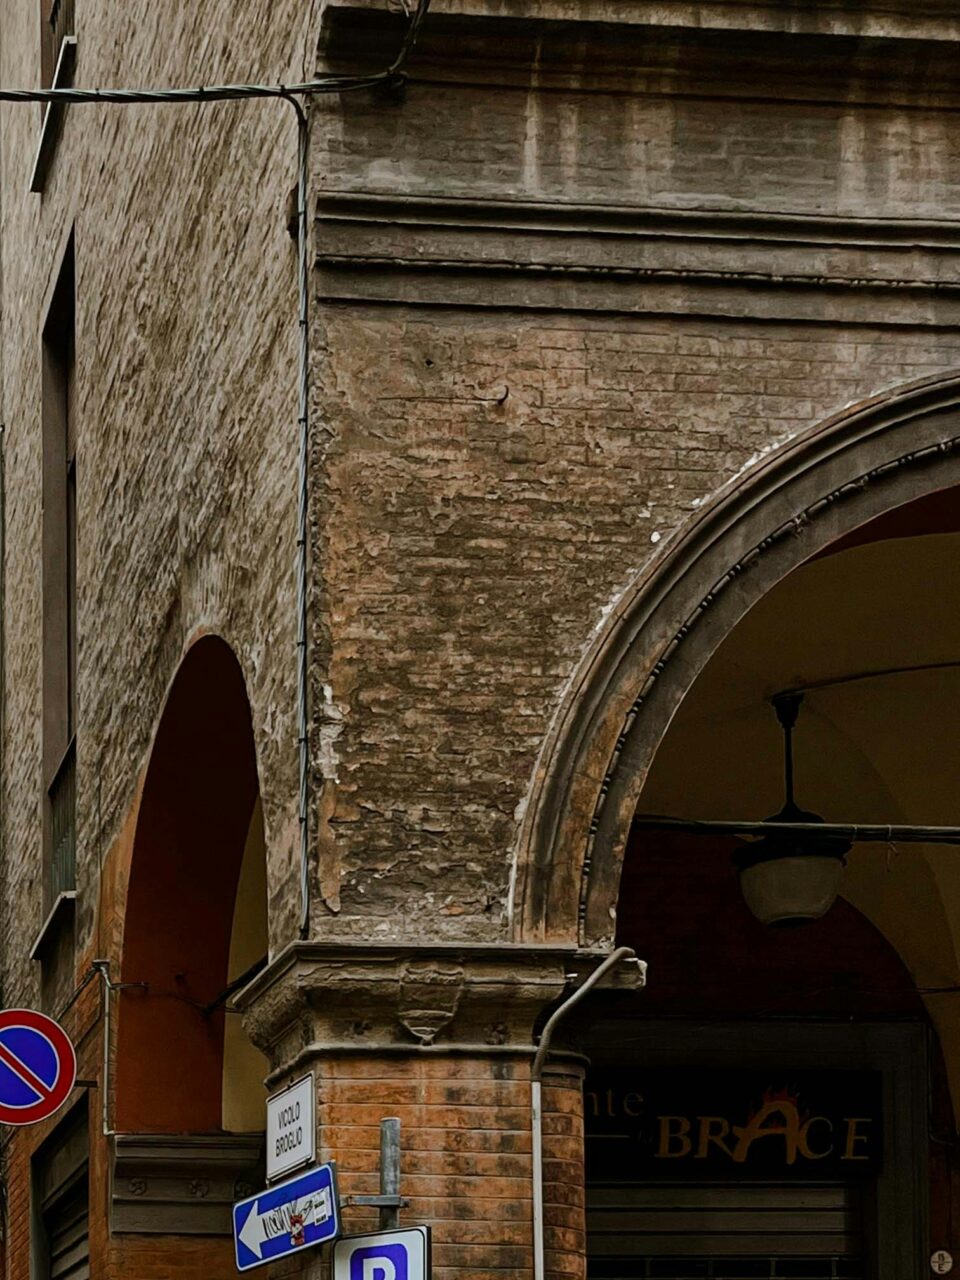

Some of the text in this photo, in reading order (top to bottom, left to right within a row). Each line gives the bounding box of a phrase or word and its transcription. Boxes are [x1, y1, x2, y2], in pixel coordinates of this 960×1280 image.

[277, 1101, 301, 1129] VICOLO
[275, 1125, 303, 1157] BROGLIO
[653, 1099, 873, 1165] BRACE
